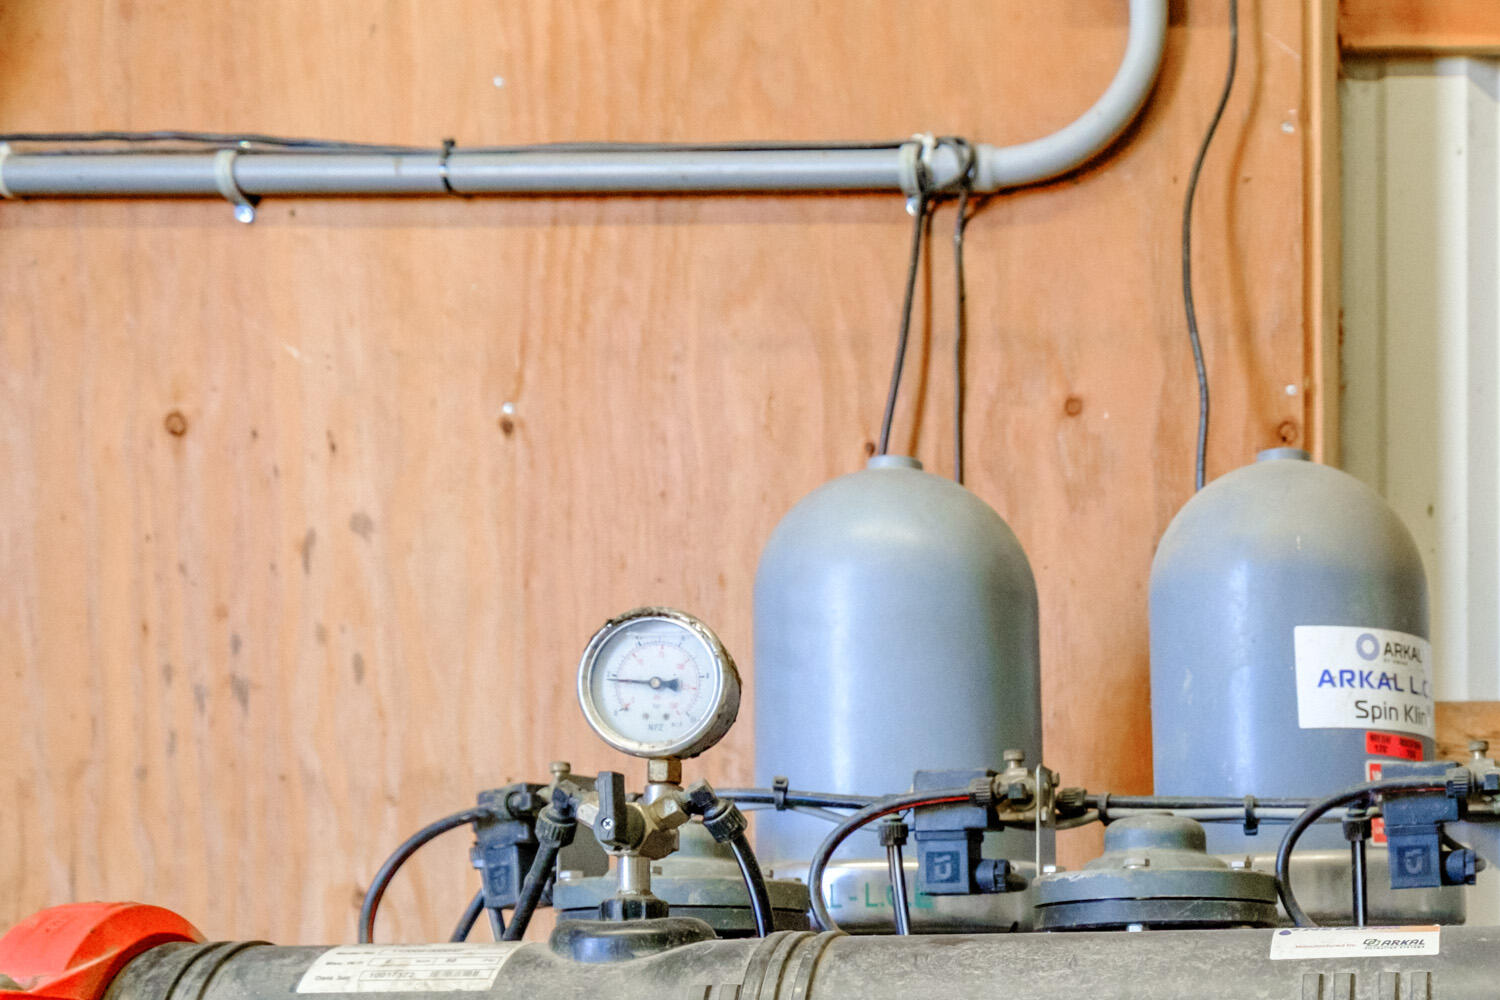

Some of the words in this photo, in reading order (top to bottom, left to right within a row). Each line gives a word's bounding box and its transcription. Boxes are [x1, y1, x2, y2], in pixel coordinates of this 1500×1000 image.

[1383, 641, 1422, 664] ARKAL
[1317, 668, 1404, 693] ARKAL
[1354, 700, 1399, 724] Spin
[1382, 938, 1425, 946] ARKAL
